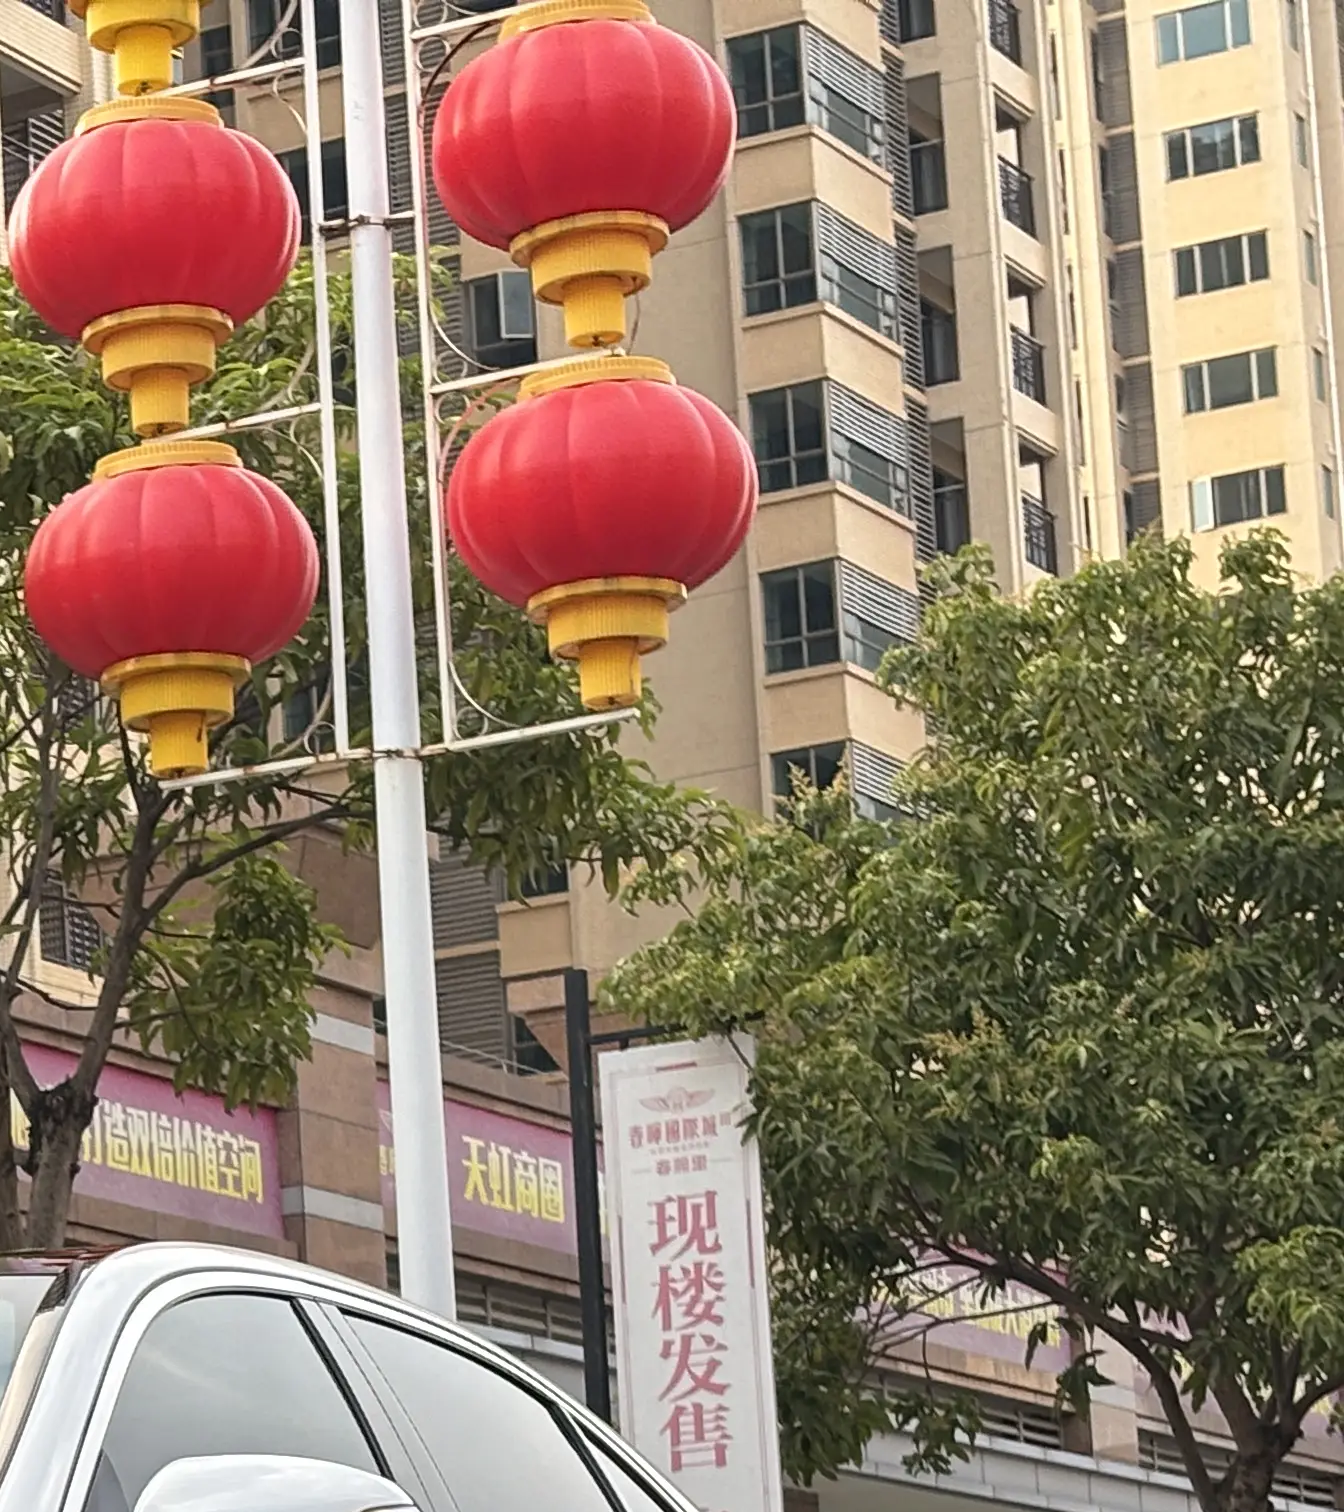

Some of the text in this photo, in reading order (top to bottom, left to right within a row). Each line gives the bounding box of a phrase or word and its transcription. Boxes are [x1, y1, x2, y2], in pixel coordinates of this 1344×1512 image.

[461, 1135, 566, 1224] 天虹商圈
[646, 1189, 734, 1473] 现楼发售
